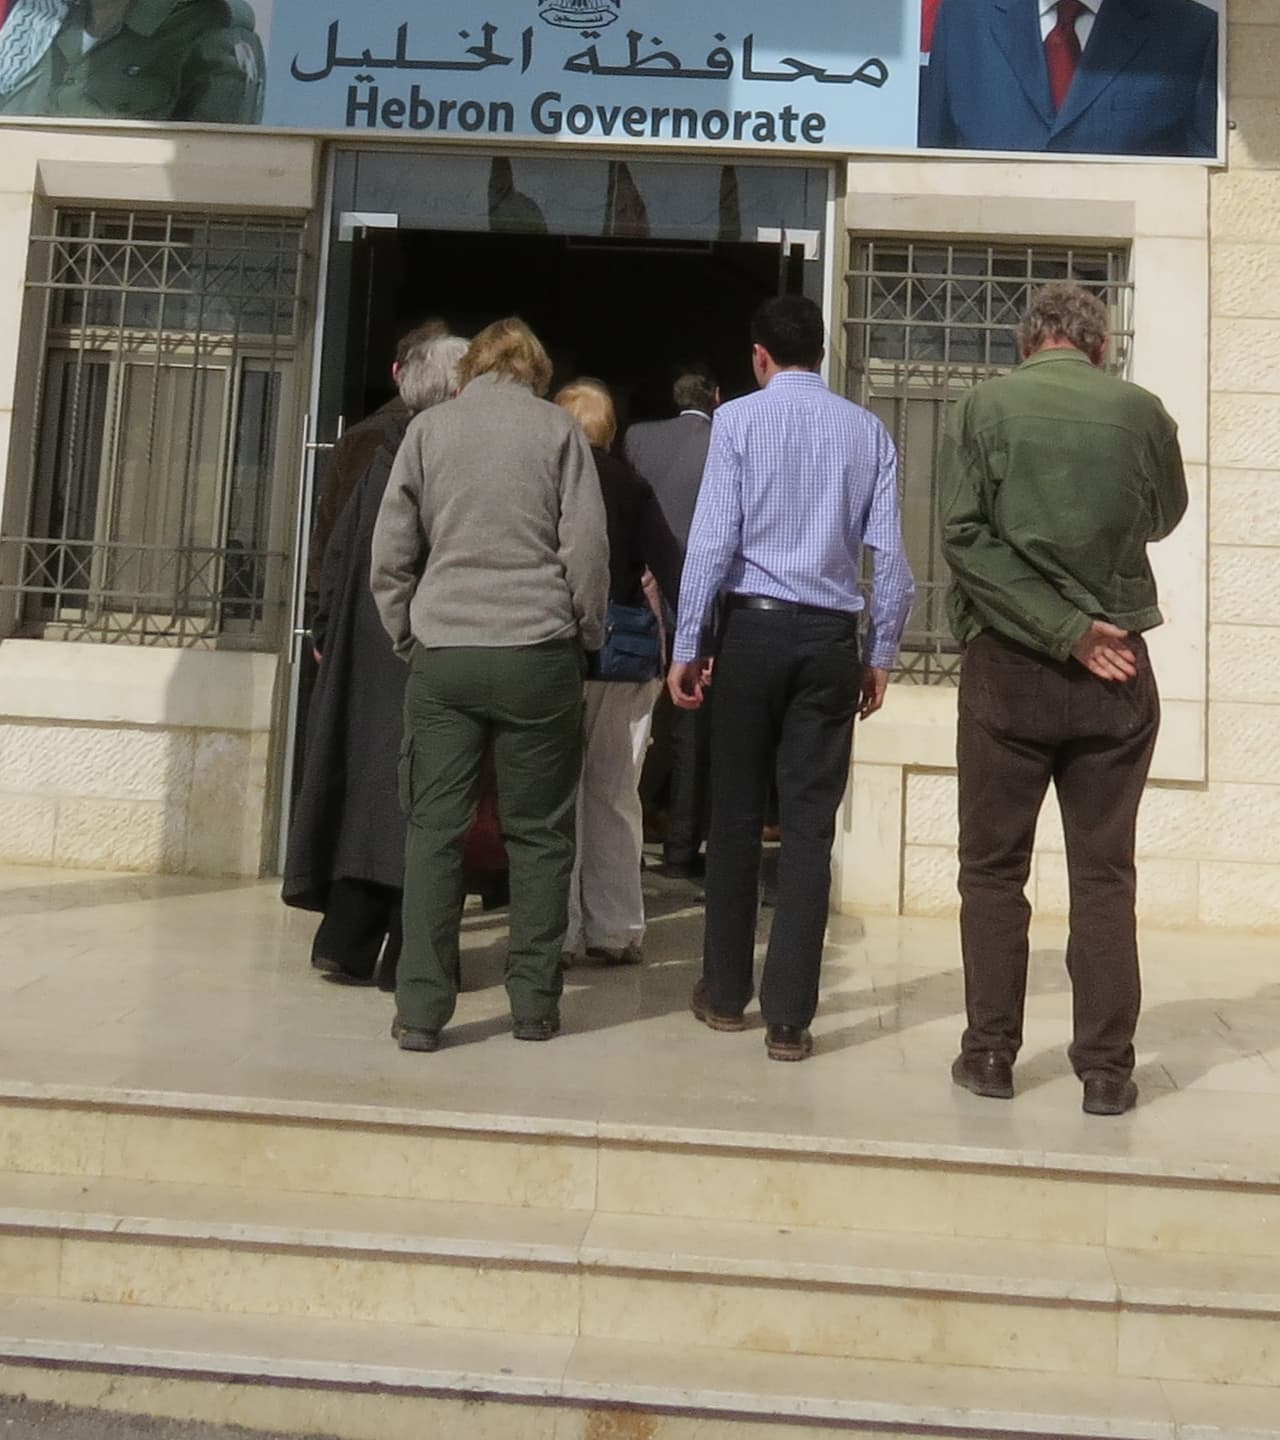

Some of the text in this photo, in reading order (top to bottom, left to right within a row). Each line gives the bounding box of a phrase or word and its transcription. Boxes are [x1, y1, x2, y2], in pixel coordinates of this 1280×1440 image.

[290, 18, 890, 89] محافظة الخليل
[345, 84, 826, 145] Hebron Governorate
